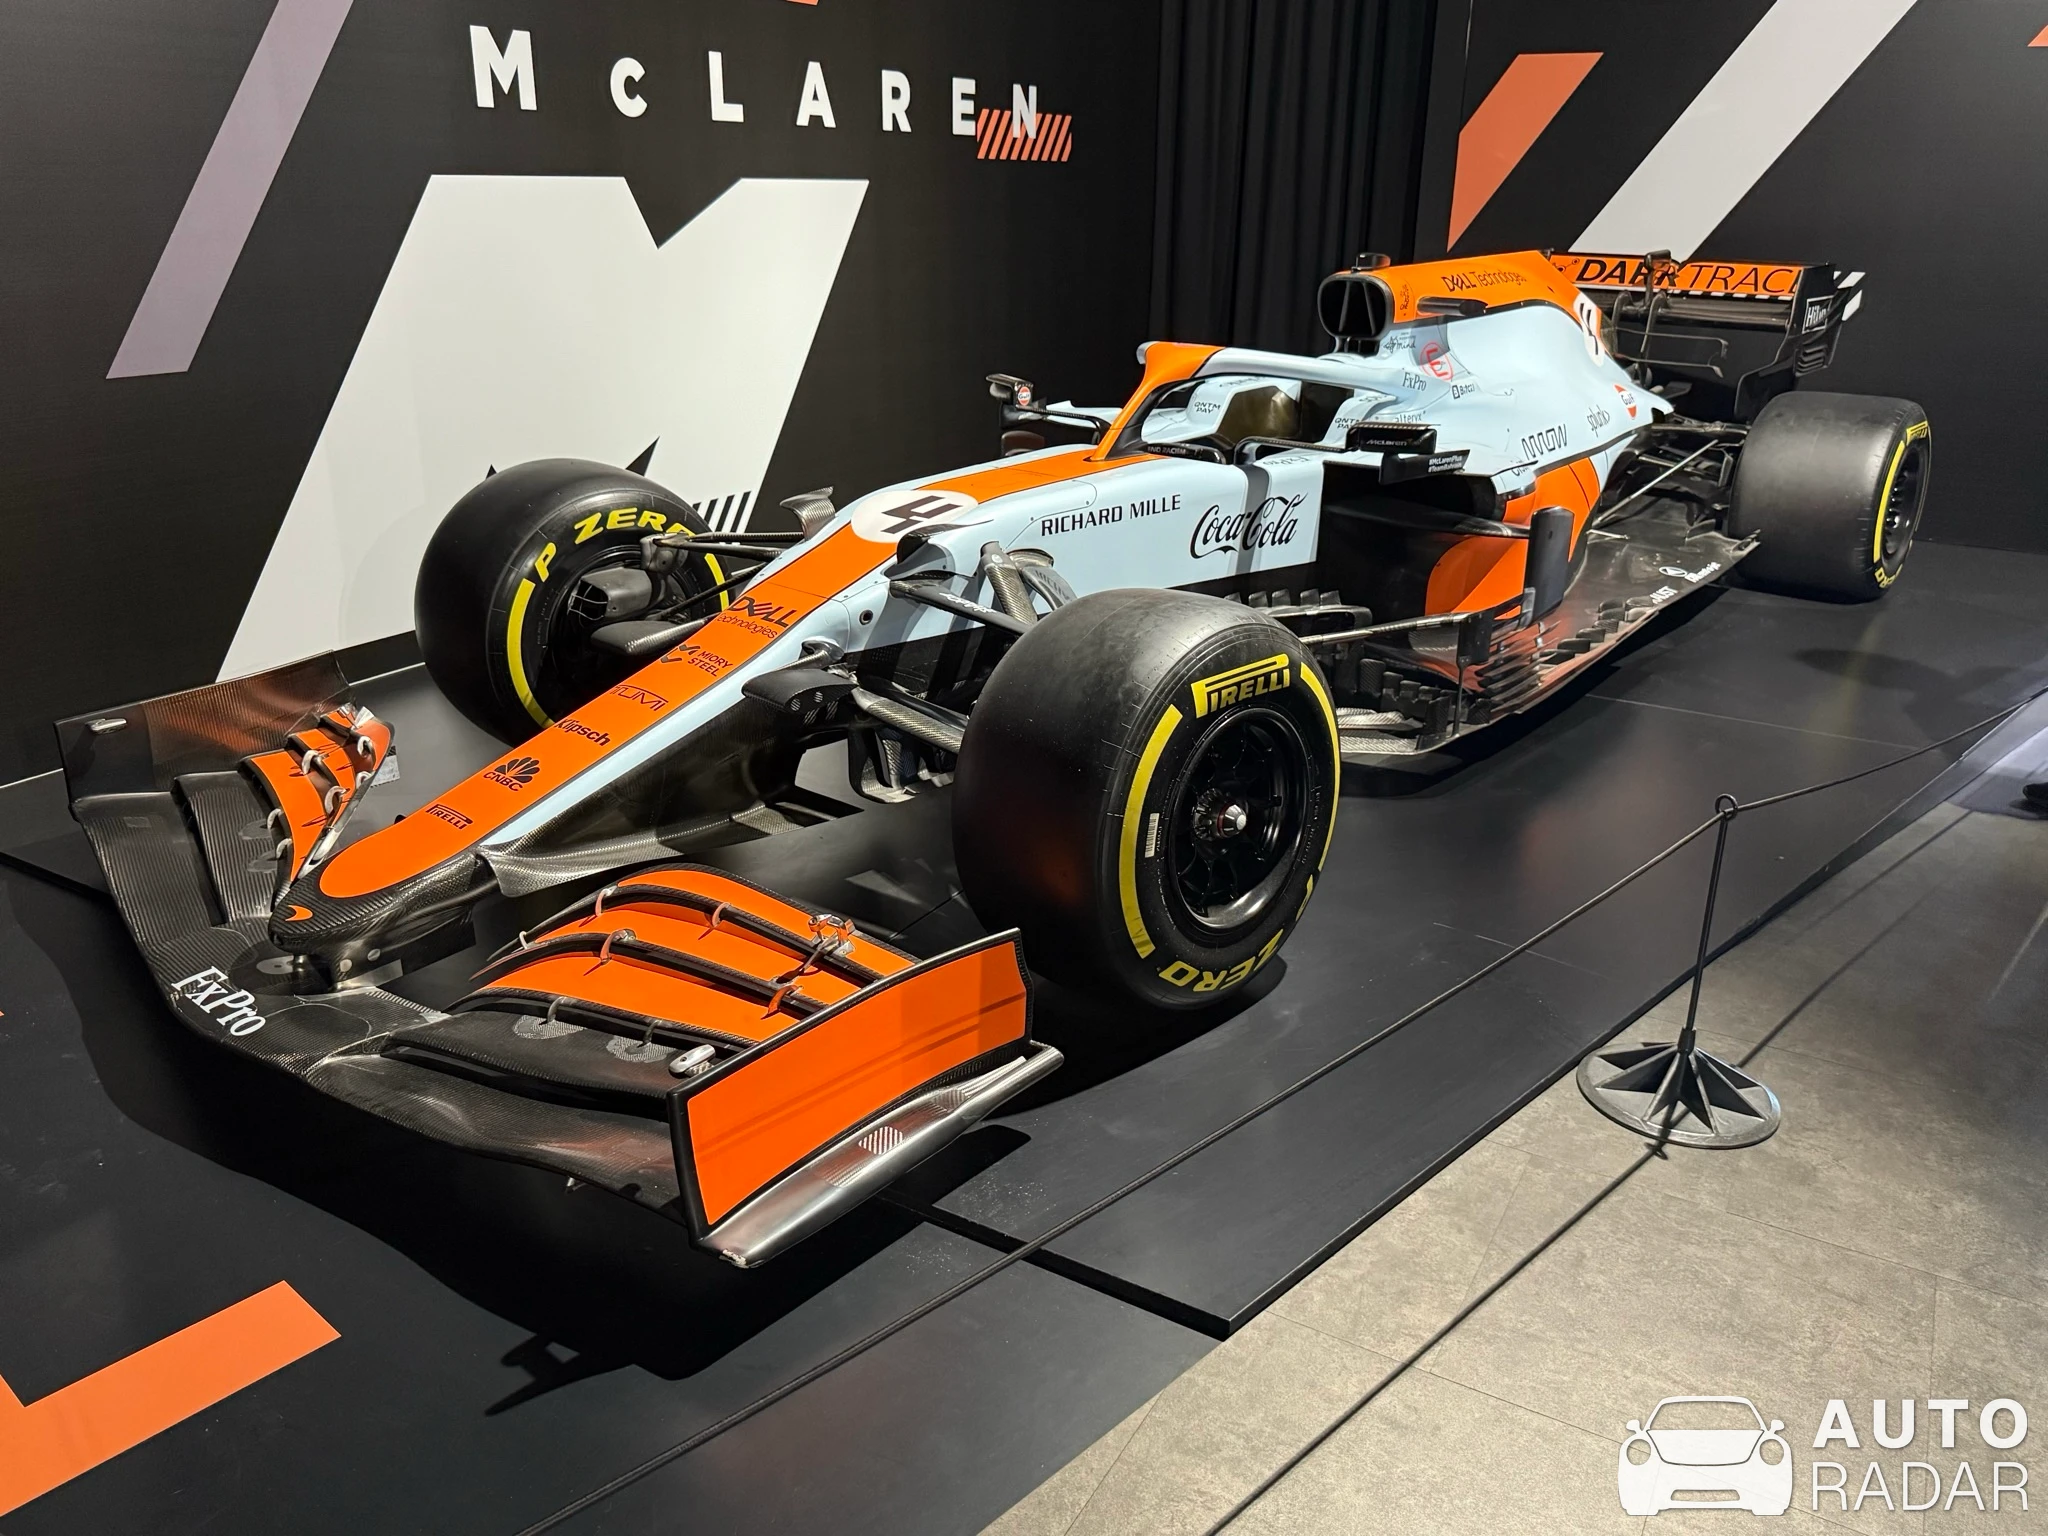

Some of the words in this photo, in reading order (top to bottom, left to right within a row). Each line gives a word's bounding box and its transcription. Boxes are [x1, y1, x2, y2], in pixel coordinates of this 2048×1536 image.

[1402, 372, 1427, 391] FxPro
[880, 495, 963, 535] 4
[1041, 505, 1122, 536] RICHARD
[1129, 493, 1181, 521] MILLE
[534, 542, 557, 582] P
[728, 595, 797, 628] DELL
[687, 657, 718, 677] STEEL
[1191, 653, 1290, 718] PIRELLI
[553, 718, 611, 746] Klipsch
[483, 770, 523, 792] CNBC
[425, 803, 473, 830] PIRELLI
[1158, 928, 1284, 992] ZERO
[170, 965, 267, 1037] FxPro
